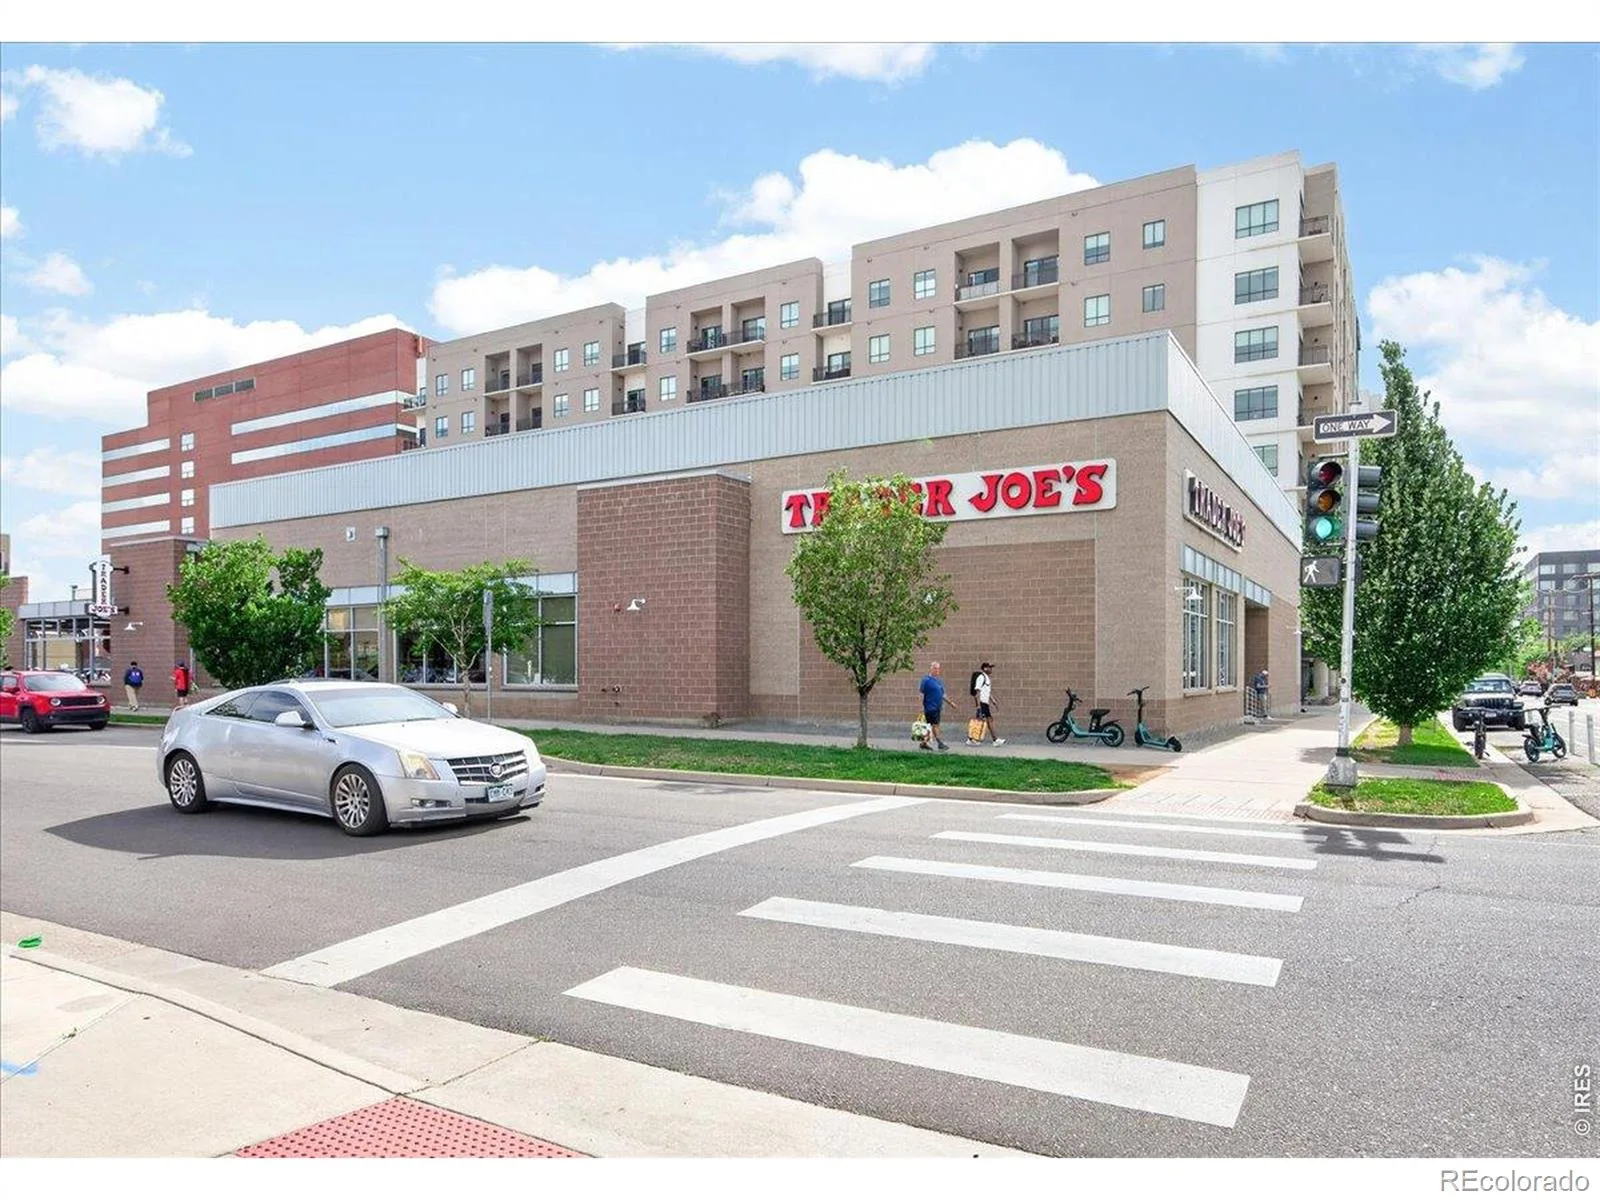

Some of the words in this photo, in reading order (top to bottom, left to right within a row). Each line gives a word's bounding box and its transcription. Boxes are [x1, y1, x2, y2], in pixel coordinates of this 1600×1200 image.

[1322, 421, 1343, 432] ONE
[1347, 418, 1370, 430] WAY
[968, 464, 1109, 513] JOE'S
